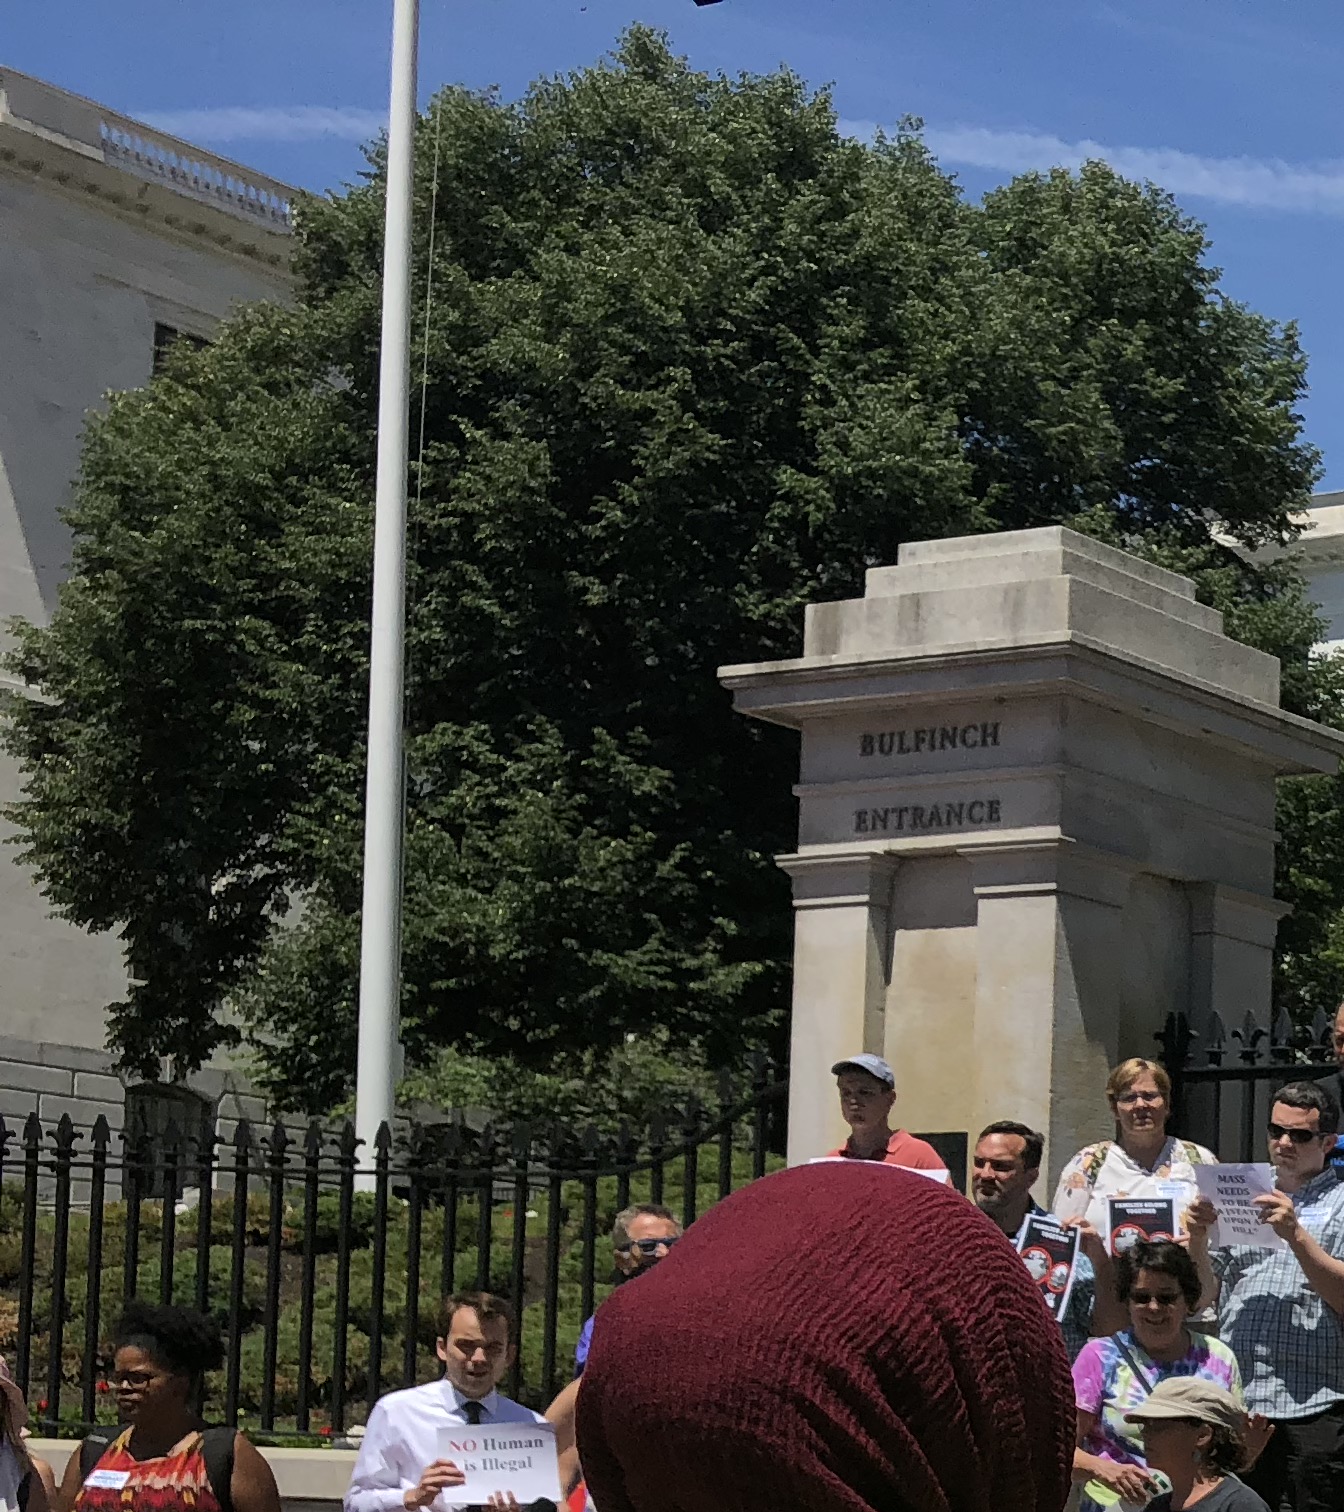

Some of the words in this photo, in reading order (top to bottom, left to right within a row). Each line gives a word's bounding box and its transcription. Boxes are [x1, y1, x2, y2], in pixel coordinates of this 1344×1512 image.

[858, 721, 1002, 757] BULFINCH
[853, 799, 1002, 833] ENTRANCE
[1217, 1174, 1246, 1184] MASS
[1215, 1186, 1251, 1196] NEEDS
[448, 1439, 478, 1453] NO
[482, 1437, 545, 1452] Human
[464, 1459, 478, 1472] is
[481, 1456, 534, 1473] Illegal
